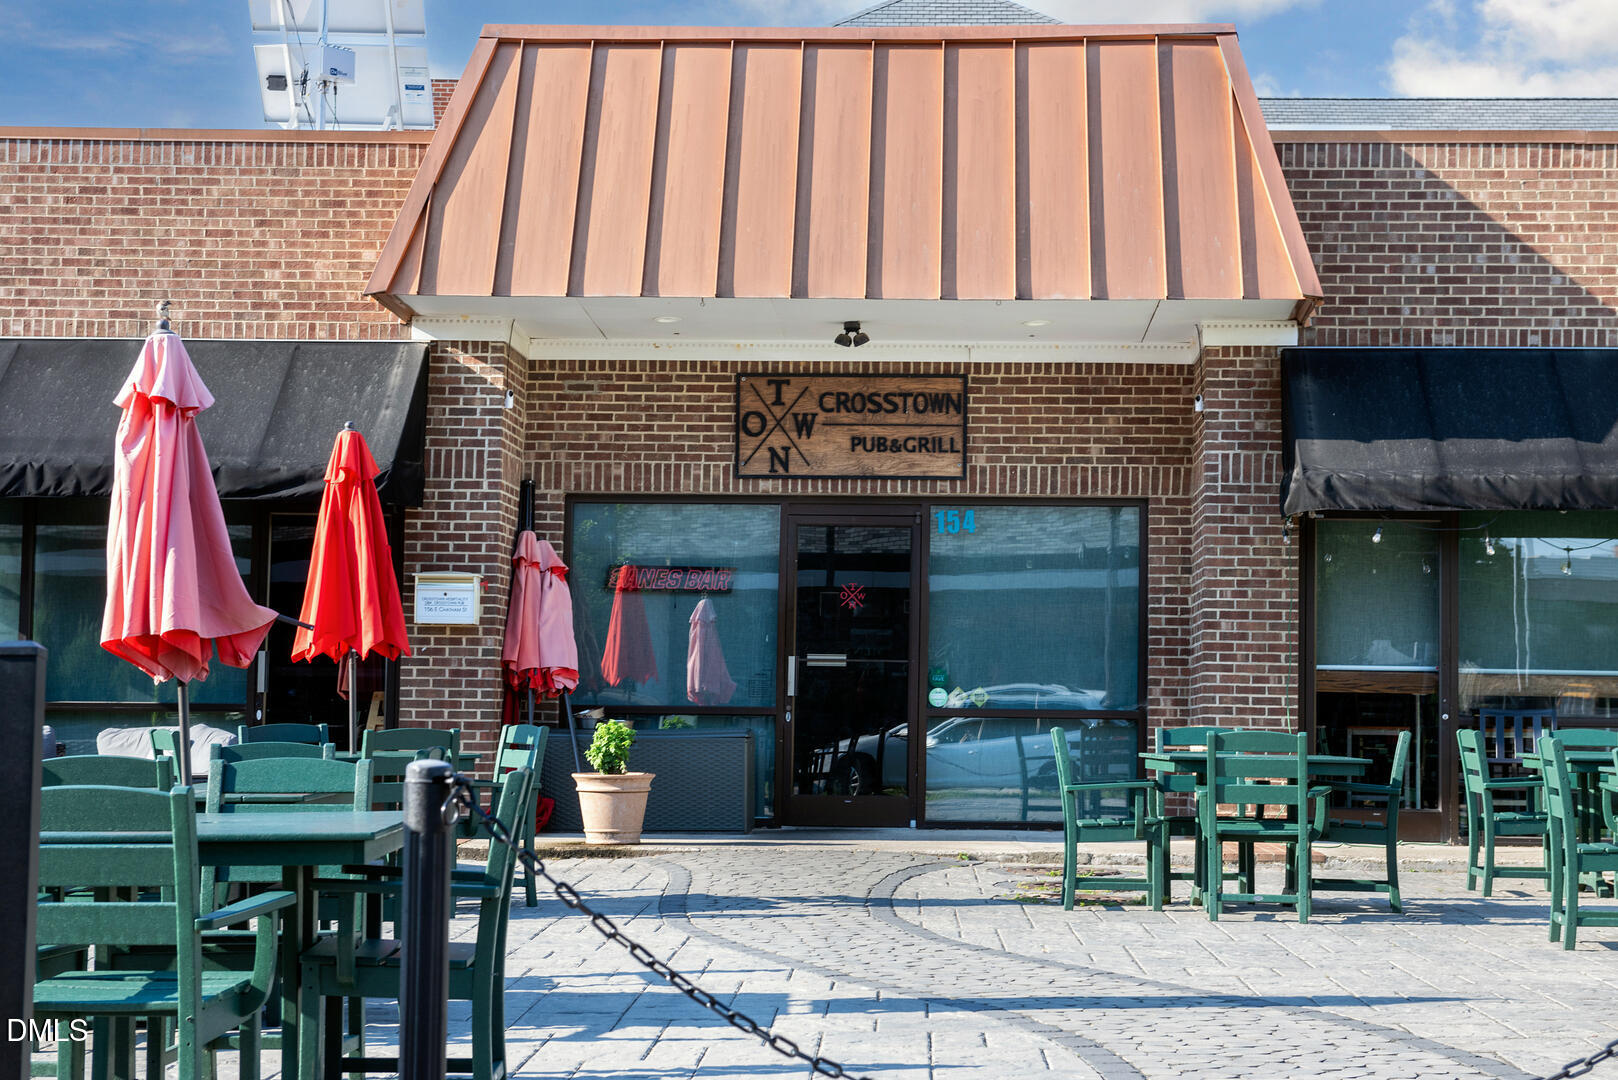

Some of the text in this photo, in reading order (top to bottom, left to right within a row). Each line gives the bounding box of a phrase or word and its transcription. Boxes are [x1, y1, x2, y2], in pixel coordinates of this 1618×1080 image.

[818, 391, 962, 415] CROSSTOWN
[850, 436, 961, 453] PUB&GRILL
[934, 510, 976, 534] 154
[684, 569, 731, 590] BAR
